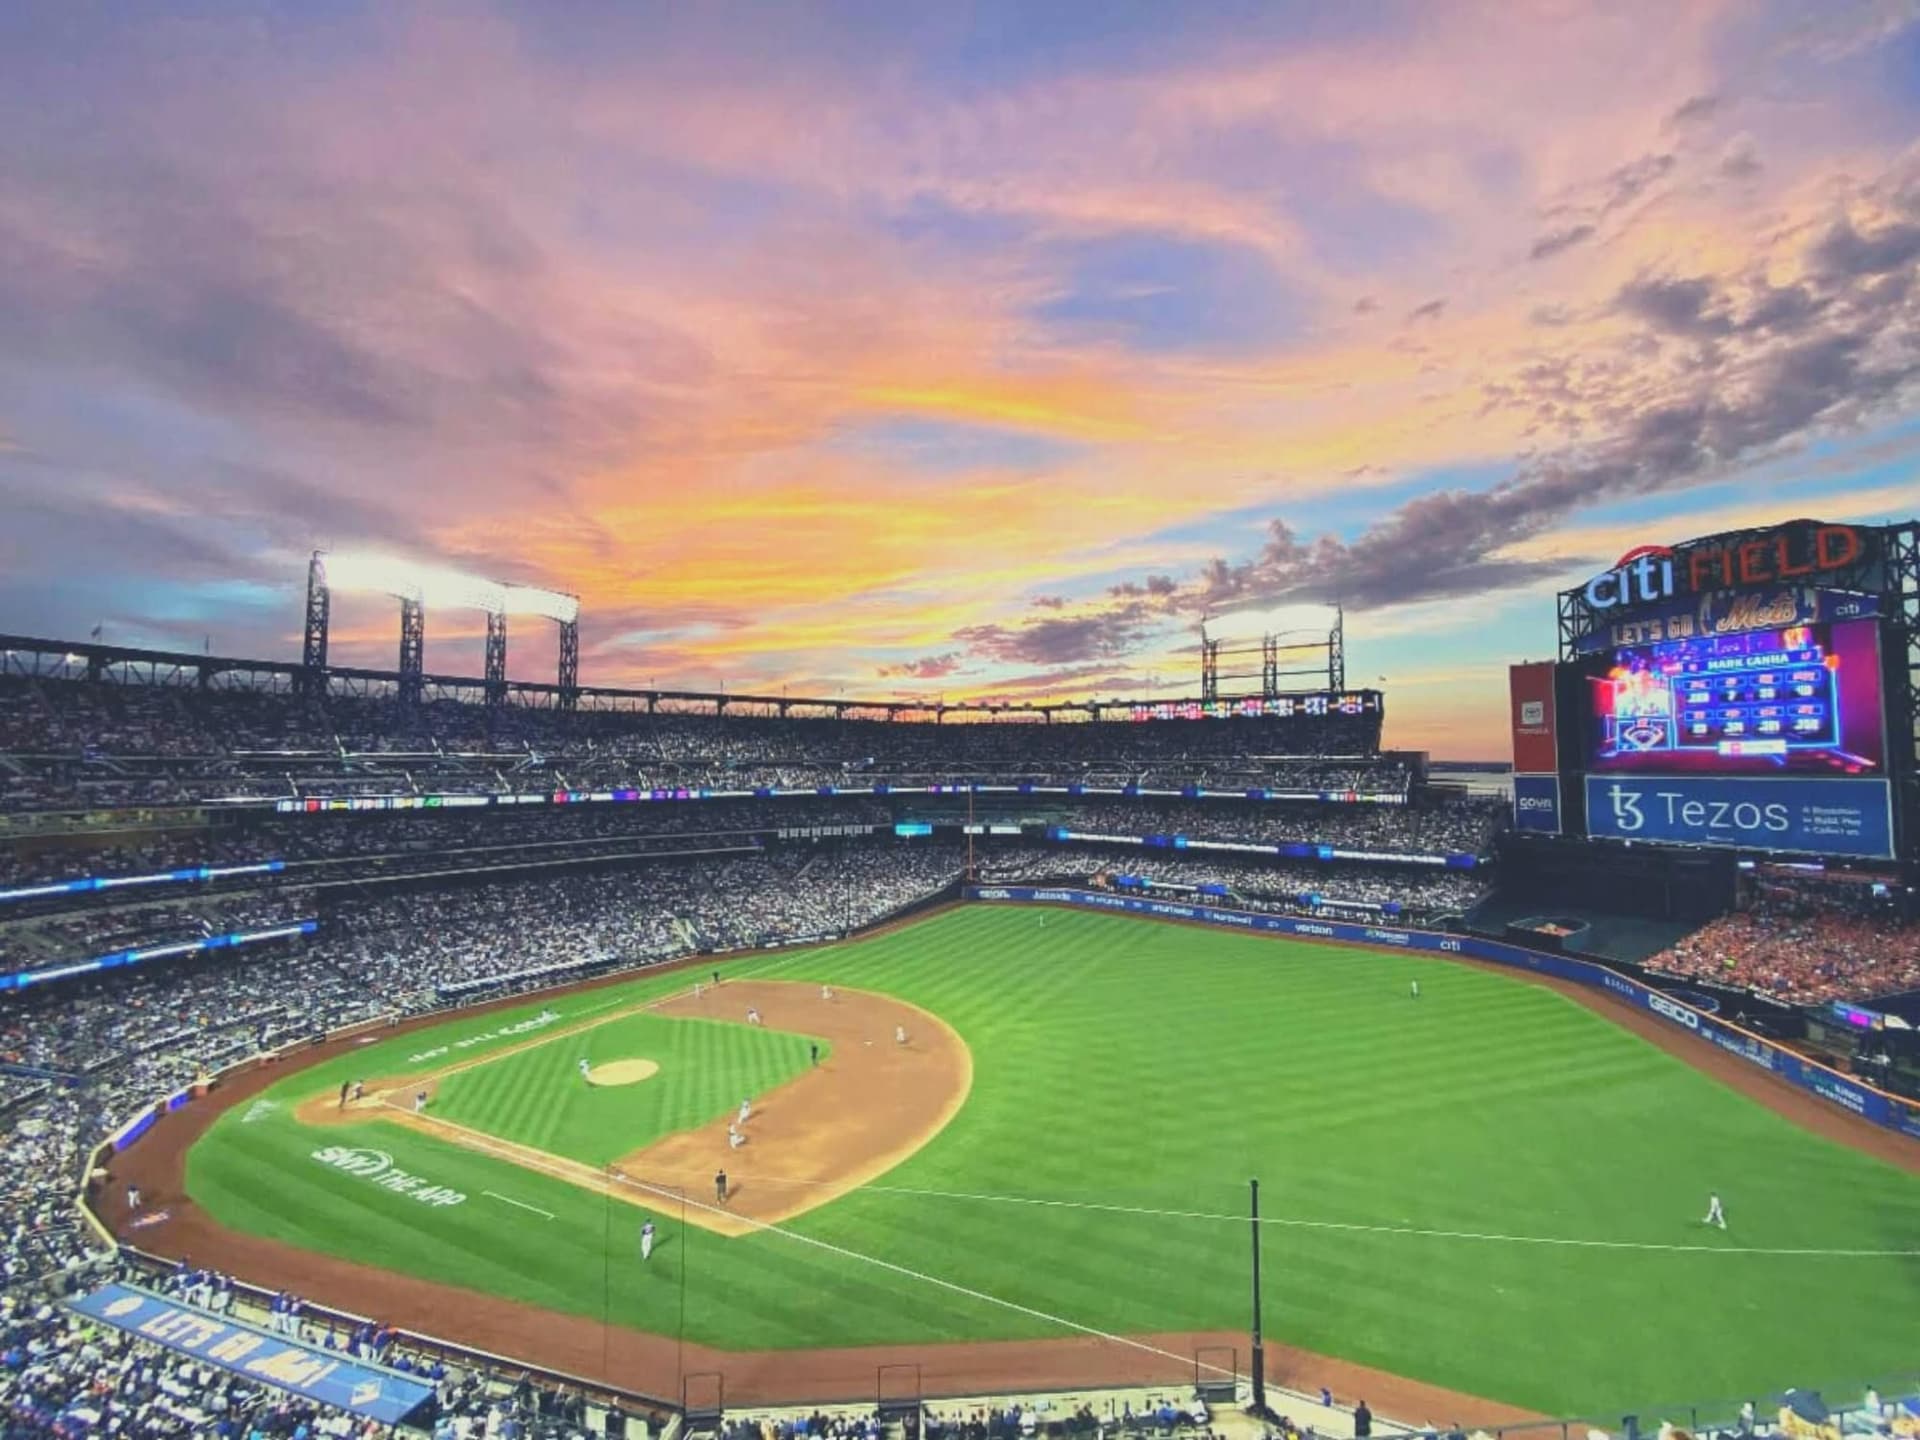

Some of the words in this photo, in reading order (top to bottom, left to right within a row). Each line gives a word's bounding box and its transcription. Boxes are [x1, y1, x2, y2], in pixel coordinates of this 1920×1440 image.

[1586, 553, 1674, 608] citi
[1689, 526, 1859, 592] FIELD
[1612, 618, 1662, 646] LET'S
[1667, 614, 1694, 639] GO
[1716, 594, 1798, 632] Mets
[1836, 604, 1860, 617] citi
[1708, 658, 1743, 671] MARK
[1746, 653, 1789, 667] CANHA
[1656, 791, 1789, 832] Tezos
[1295, 923, 1333, 936] verizon
[1440, 939, 1461, 951] citi
[1649, 993, 1699, 1030] GEICO
[371, 1168, 428, 1192] THE
[408, 1185, 467, 1207] APP
[138, 1309, 226, 1348] LET'S
